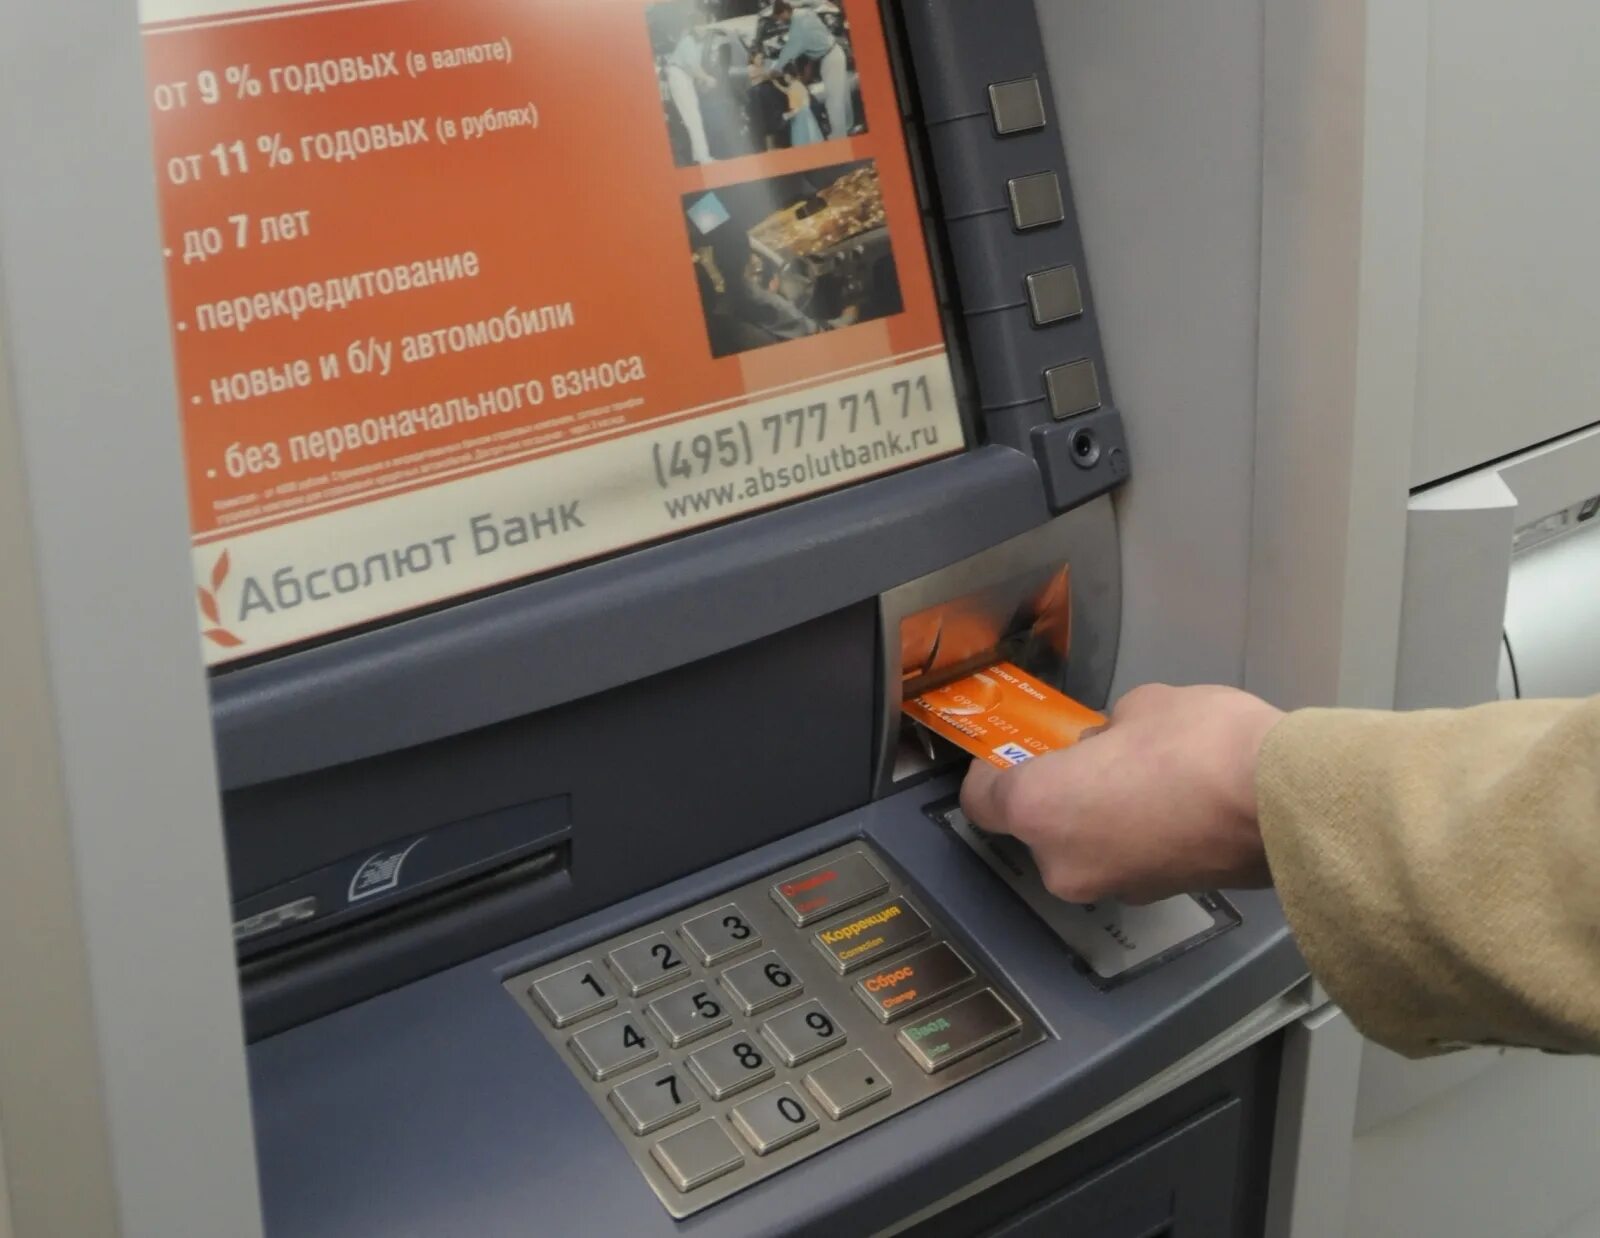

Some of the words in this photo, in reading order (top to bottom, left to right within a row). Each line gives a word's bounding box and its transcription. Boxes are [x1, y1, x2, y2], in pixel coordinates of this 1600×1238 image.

[154, 81, 187, 112] от
[198, 70, 219, 105] 9
[226, 64, 261, 101] %
[269, 51, 399, 95] годовых
[406, 50, 427, 79] (в
[432, 36, 512, 71] валюте)
[167, 154, 202, 185] от
[210, 139, 249, 177] 11
[257, 133, 293, 168] %
[301, 117, 429, 163] годовых
[436, 116, 457, 145] (в
[461, 101, 539, 142] рублях)
[183, 227, 222, 264] до
[228, 215, 249, 248] 7
[259, 209, 310, 246] лет
[195, 250, 480, 332] перекредитование
[210, 358, 312, 406] новые
[319, 353, 340, 382] и
[346, 337, 393, 377] б/у
[400, 301, 575, 364] автомобили
[225, 441, 281, 480] без
[288, 378, 544, 463] первоначального
[552, 354, 646, 401] взноса
[653, 420, 754, 485] (495)
[762, 402, 827, 455] 777
[840, 389, 881, 433] 71
[892, 375, 933, 418] 71
[664, 424, 939, 520] www.absolutbank.ru
[236, 532, 457, 622] Абсолют
[472, 500, 585, 557] Банк
[723, 916, 750, 940] 3
[821, 906, 901, 944] Коррекция
[652, 943, 681, 970] 2
[581, 974, 606, 998] 1
[764, 963, 792, 988] 6
[865, 966, 914, 992] Сброс
[693, 992, 720, 1020] 5
[623, 1025, 645, 1050] 4
[805, 1011, 834, 1037] 9
[734, 1043, 763, 1070] 8
[656, 1075, 682, 1105] 7
[777, 1097, 806, 1124] 0
